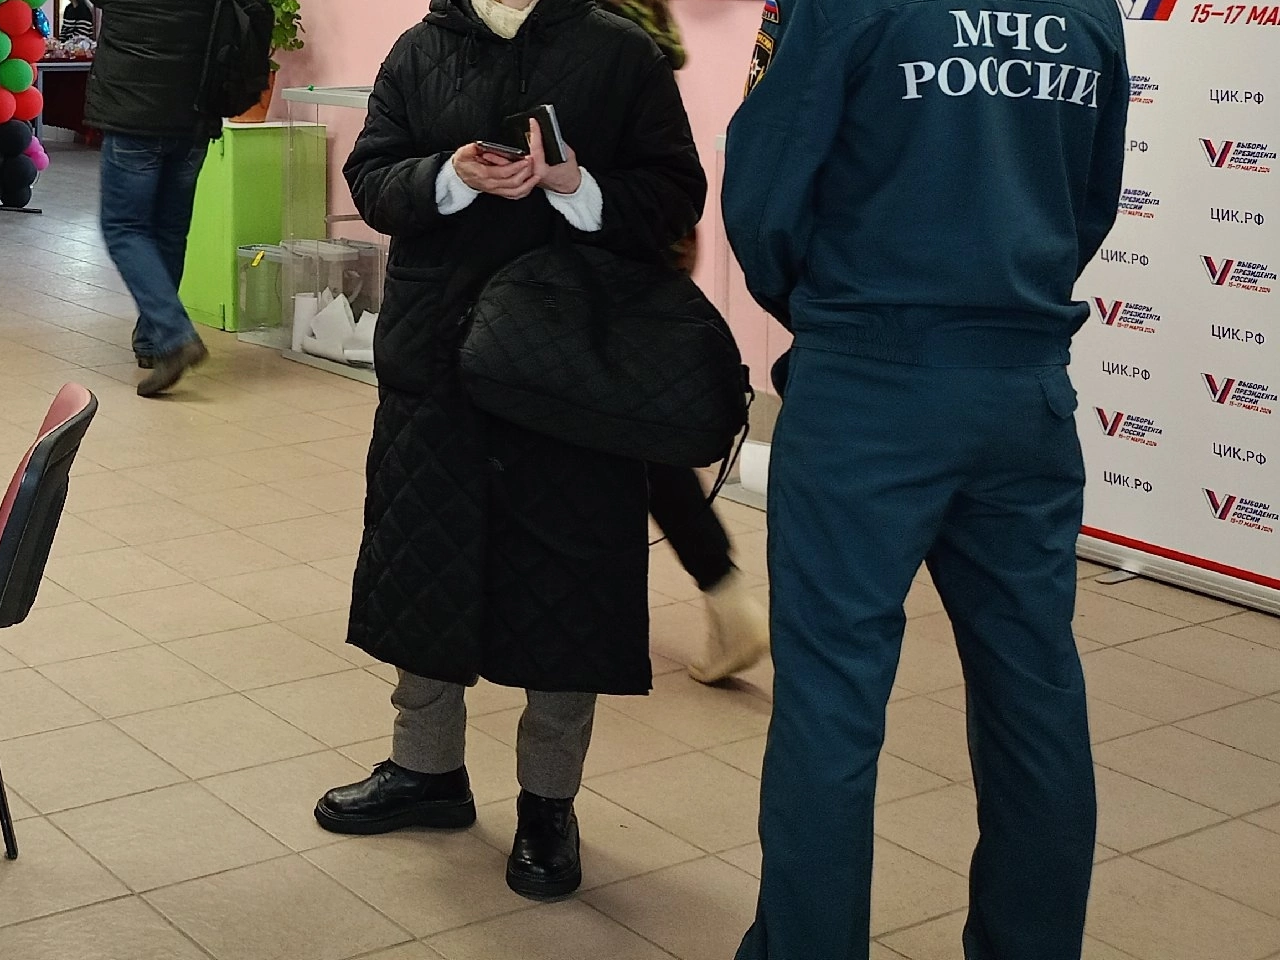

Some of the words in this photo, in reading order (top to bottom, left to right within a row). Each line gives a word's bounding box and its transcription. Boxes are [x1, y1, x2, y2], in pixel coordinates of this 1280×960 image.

[1246, 5, 1280, 26] МА
[948, 9, 1067, 54] МЧС
[898, 56, 1102, 108] РОССИИ
[1210, 89, 1264, 105] ЦИК.РФ
[1210, 208, 1264, 226] ЦИК.РФ
[1100, 249, 1149, 266] ЦИК.РФ
[1211, 324, 1265, 345] ЦИК.РФ
[1102, 360, 1151, 381] ЦИК.РФ
[1213, 442, 1267, 465] ЦИК.РФ
[1103, 470, 1153, 493] ЦИК.РФ
